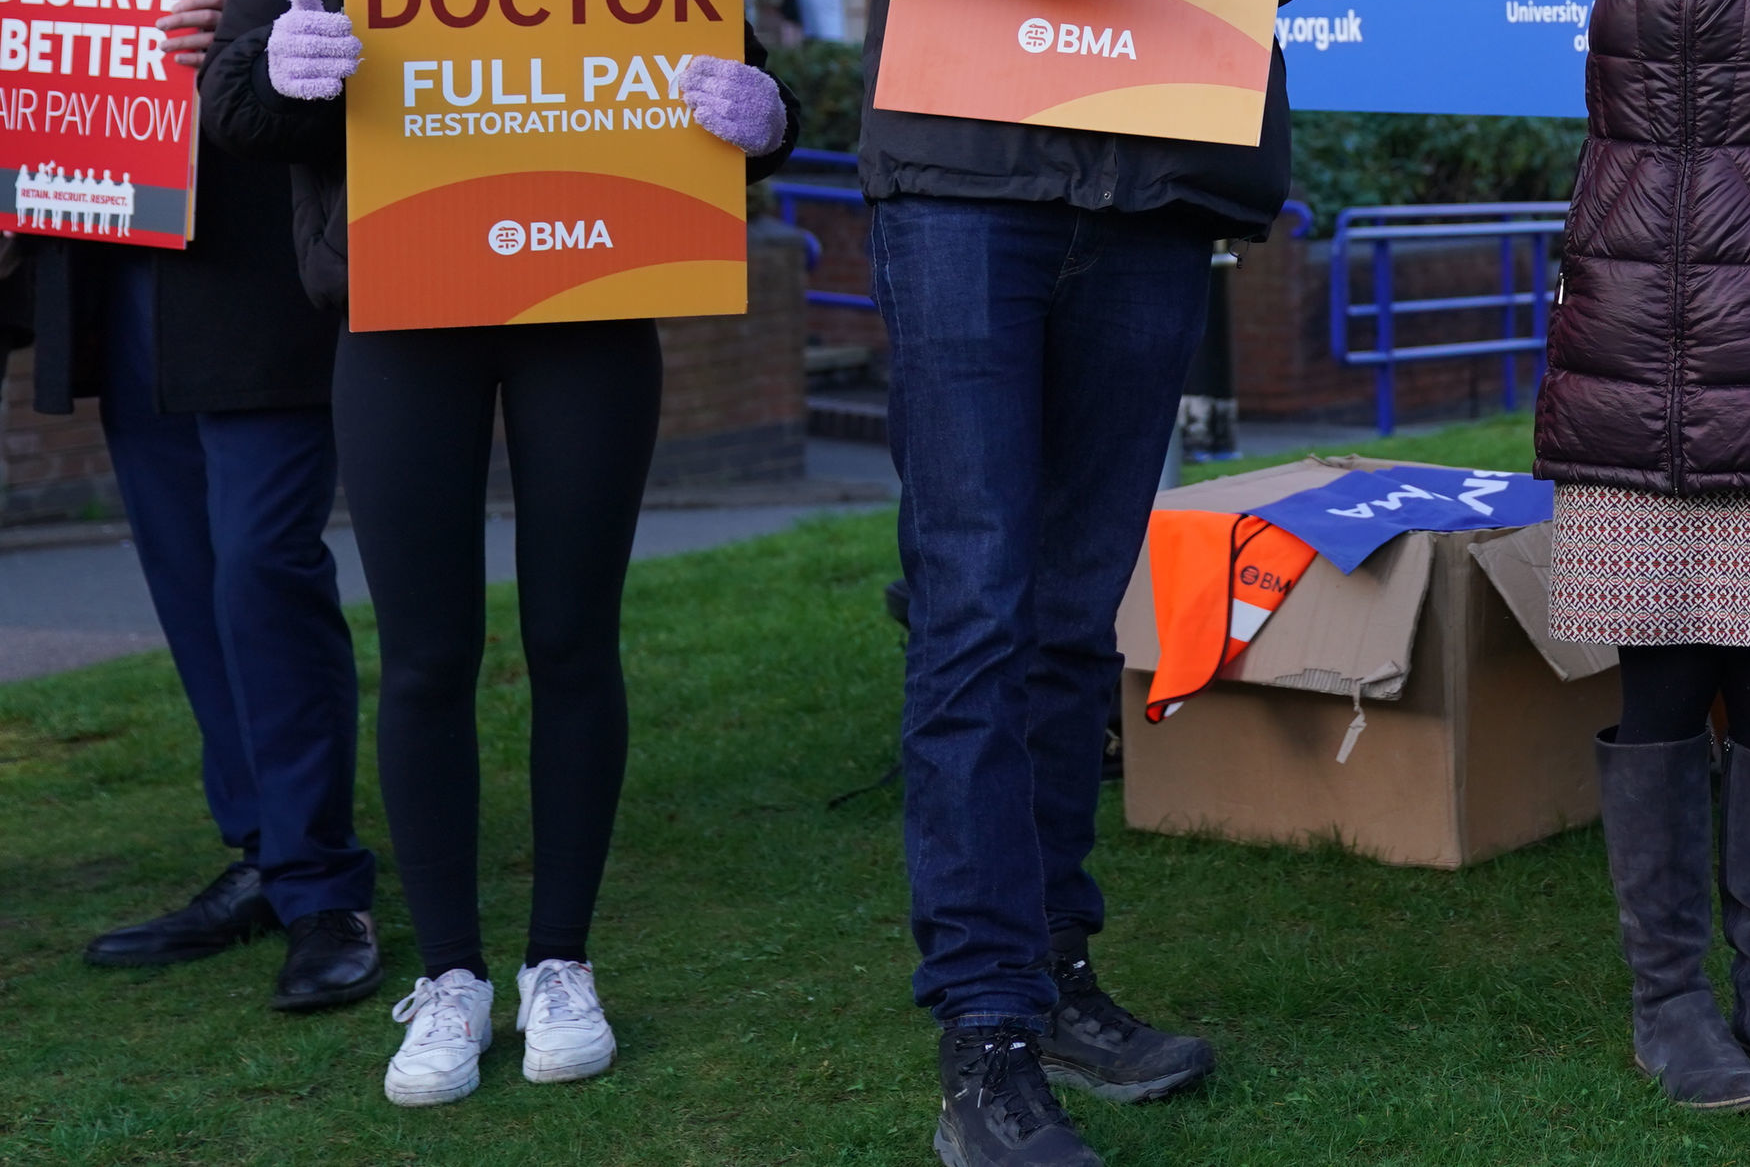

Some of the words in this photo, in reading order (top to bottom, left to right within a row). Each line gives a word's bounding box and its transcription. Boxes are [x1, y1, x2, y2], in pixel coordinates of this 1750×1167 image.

[1506, 0, 1588, 28] University
[0, 18, 167, 82] BETTER
[1056, 23, 1137, 61] BMA
[403, 58, 566, 108] FULL
[583, 54, 694, 103] PAY
[45, 90, 101, 136] PAY
[105, 95, 188, 144] NOW
[404, 109, 614, 138] RESTORATION
[623, 107, 694, 131] NOW
[20, 188, 51, 200] RETAIN.
[53, 190, 89, 203] RECRUIT.
[90, 194, 128, 207] RESPECT.
[530, 219, 614, 252] BMA
